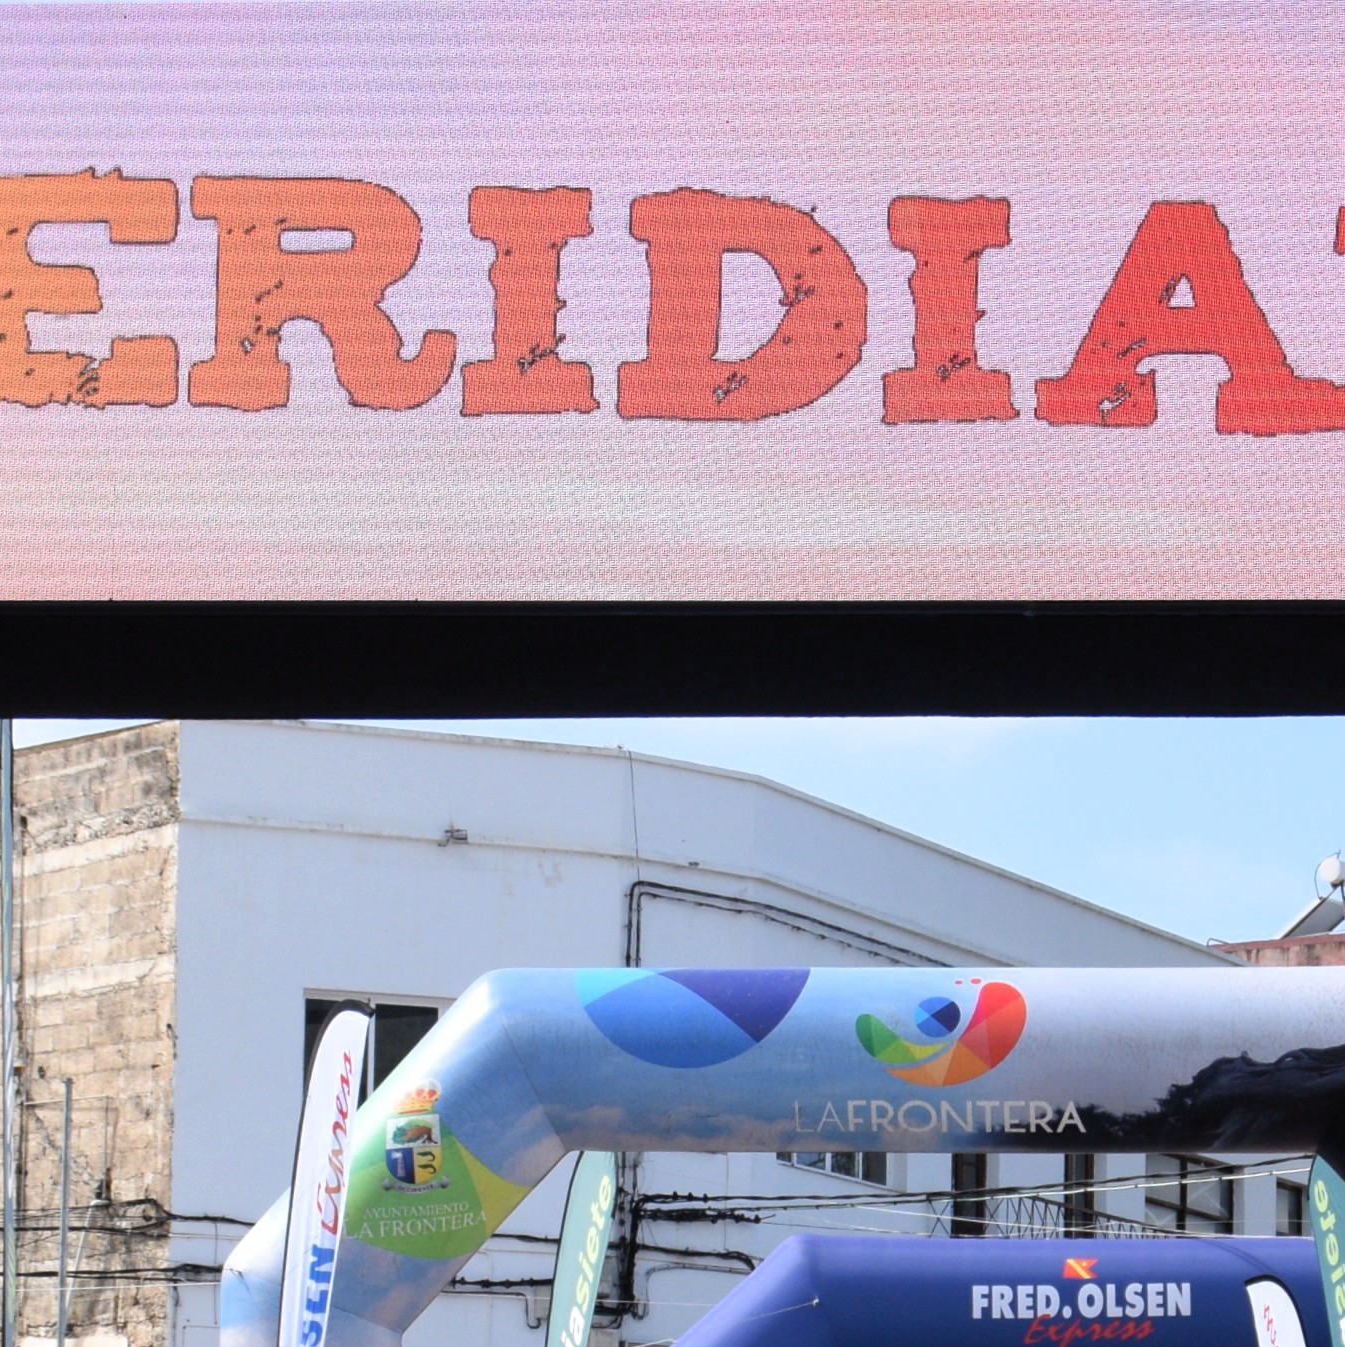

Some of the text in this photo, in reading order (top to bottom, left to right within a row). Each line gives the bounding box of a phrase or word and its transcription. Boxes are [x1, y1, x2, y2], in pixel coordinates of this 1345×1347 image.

[365, 1201, 470, 1220] AYUNTAMIENTO
[343, 1210, 487, 1239] LA FRONTERA
